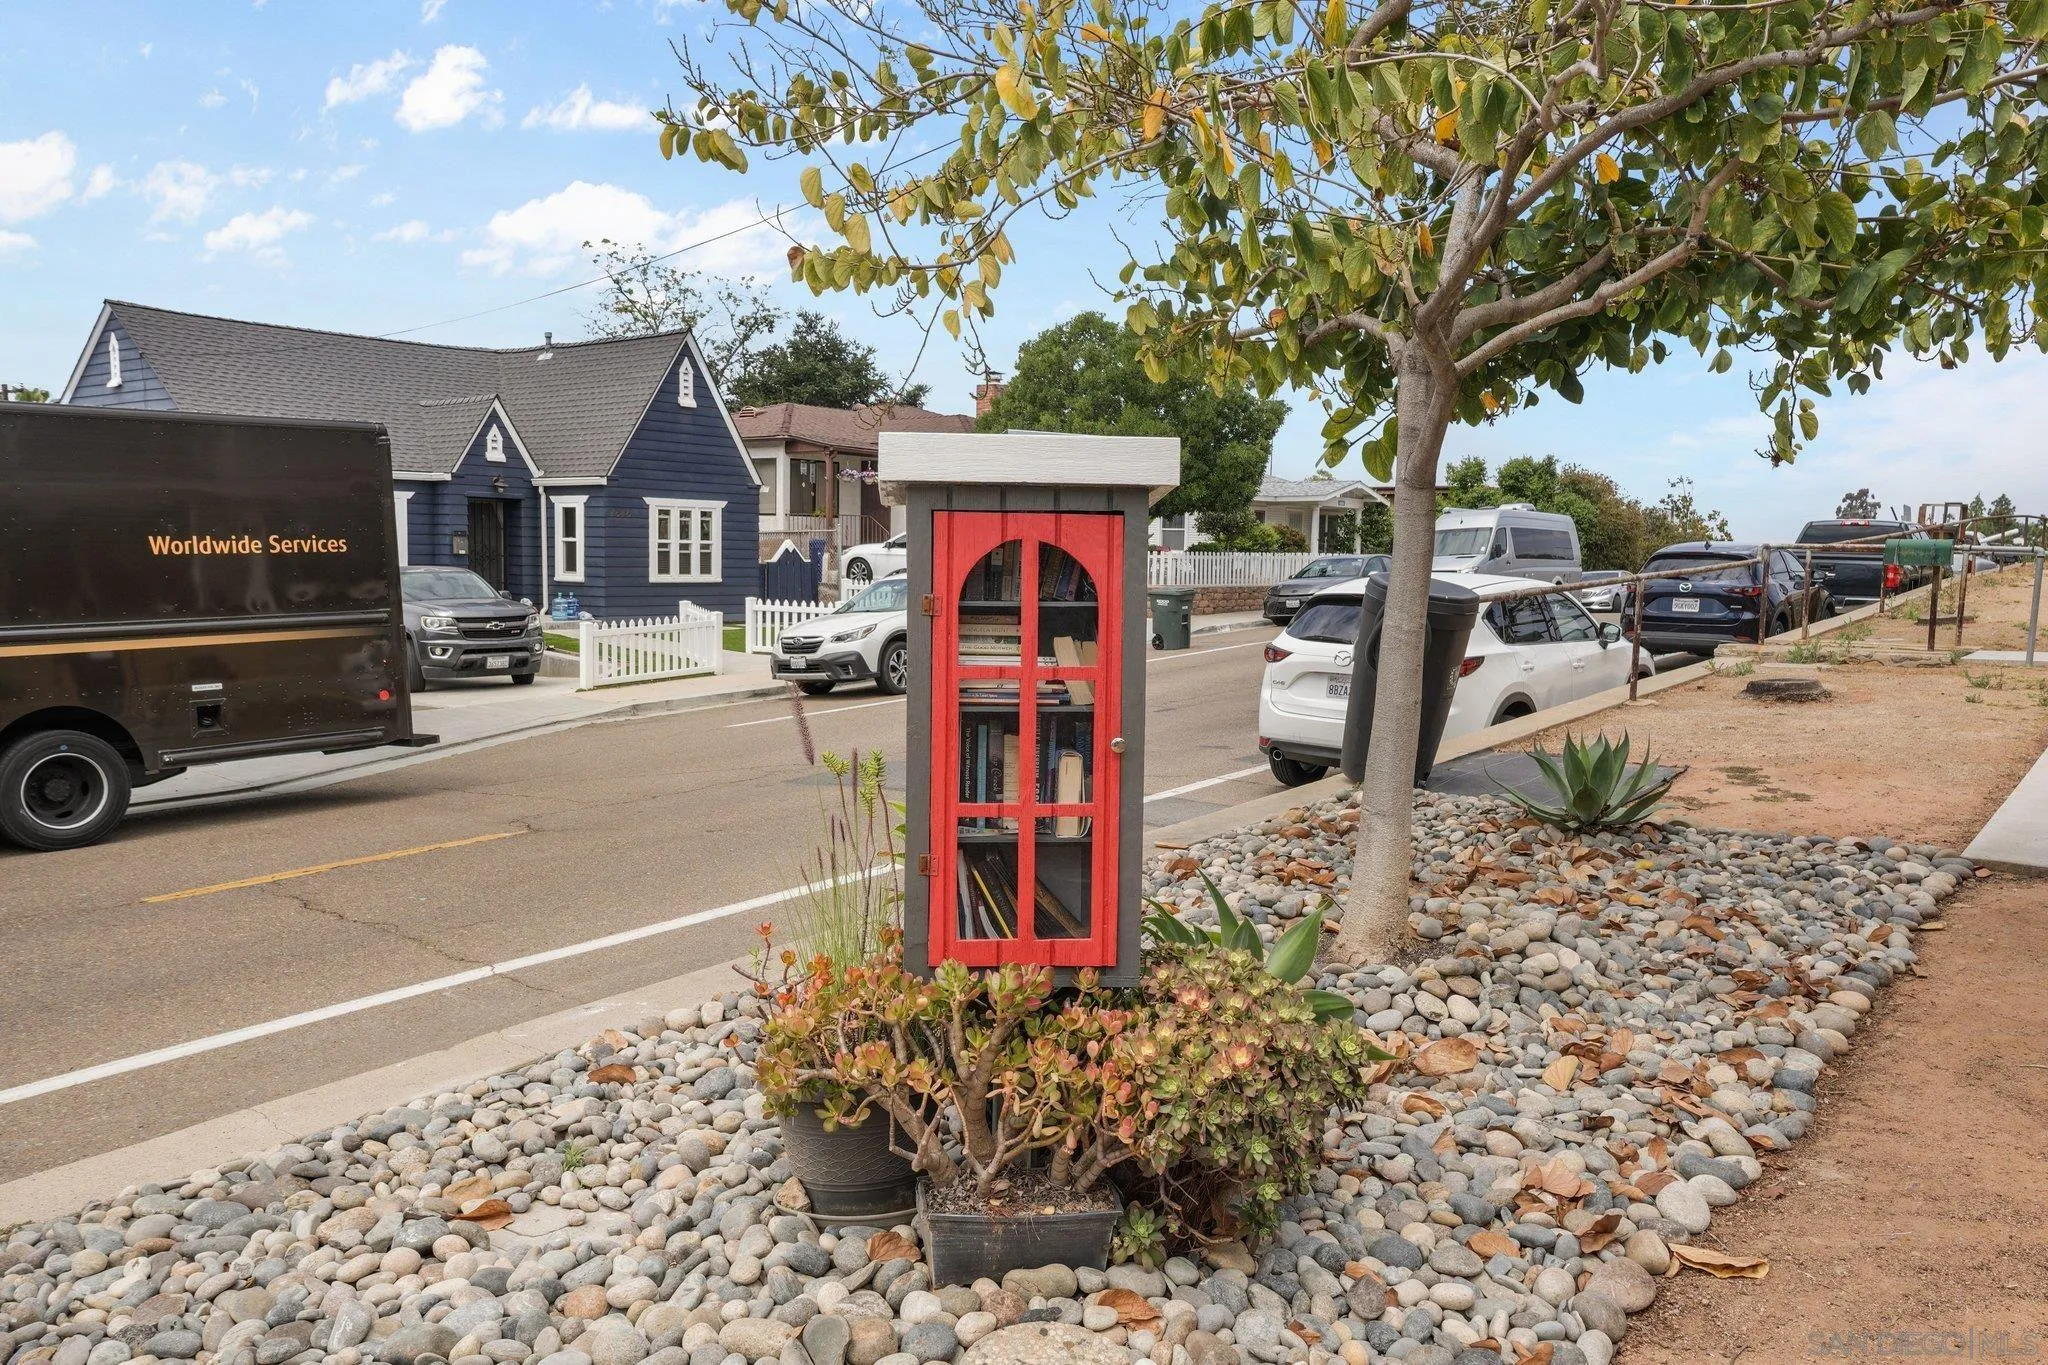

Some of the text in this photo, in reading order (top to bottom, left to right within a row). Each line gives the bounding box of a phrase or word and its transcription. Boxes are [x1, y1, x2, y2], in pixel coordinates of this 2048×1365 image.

[148, 535, 347, 555] Worldwide Services
[1328, 684, 1351, 696] 8BZA
